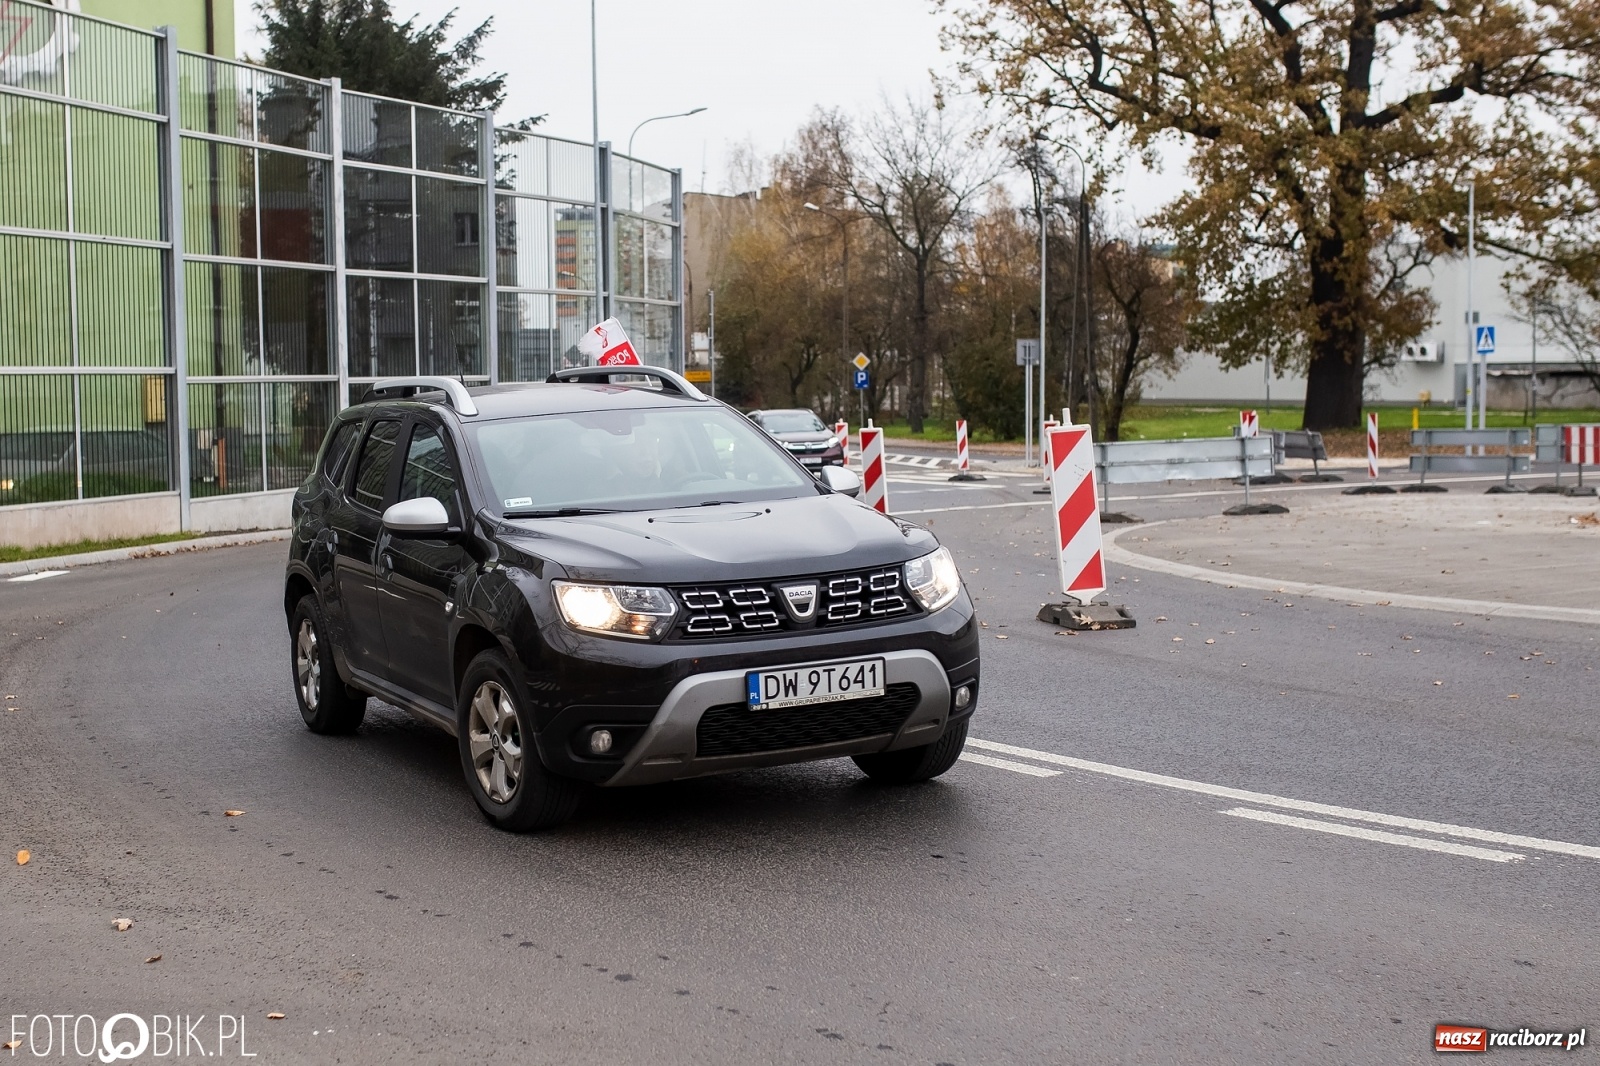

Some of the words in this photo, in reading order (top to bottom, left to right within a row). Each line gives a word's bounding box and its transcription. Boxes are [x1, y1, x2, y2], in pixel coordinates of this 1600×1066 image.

[857, 371, 867, 384] P
[788, 590, 813, 598] DACIA
[764, 671, 799, 700] DW
[808, 663, 877, 696] 9T641
[750, 692, 759, 700] PL
